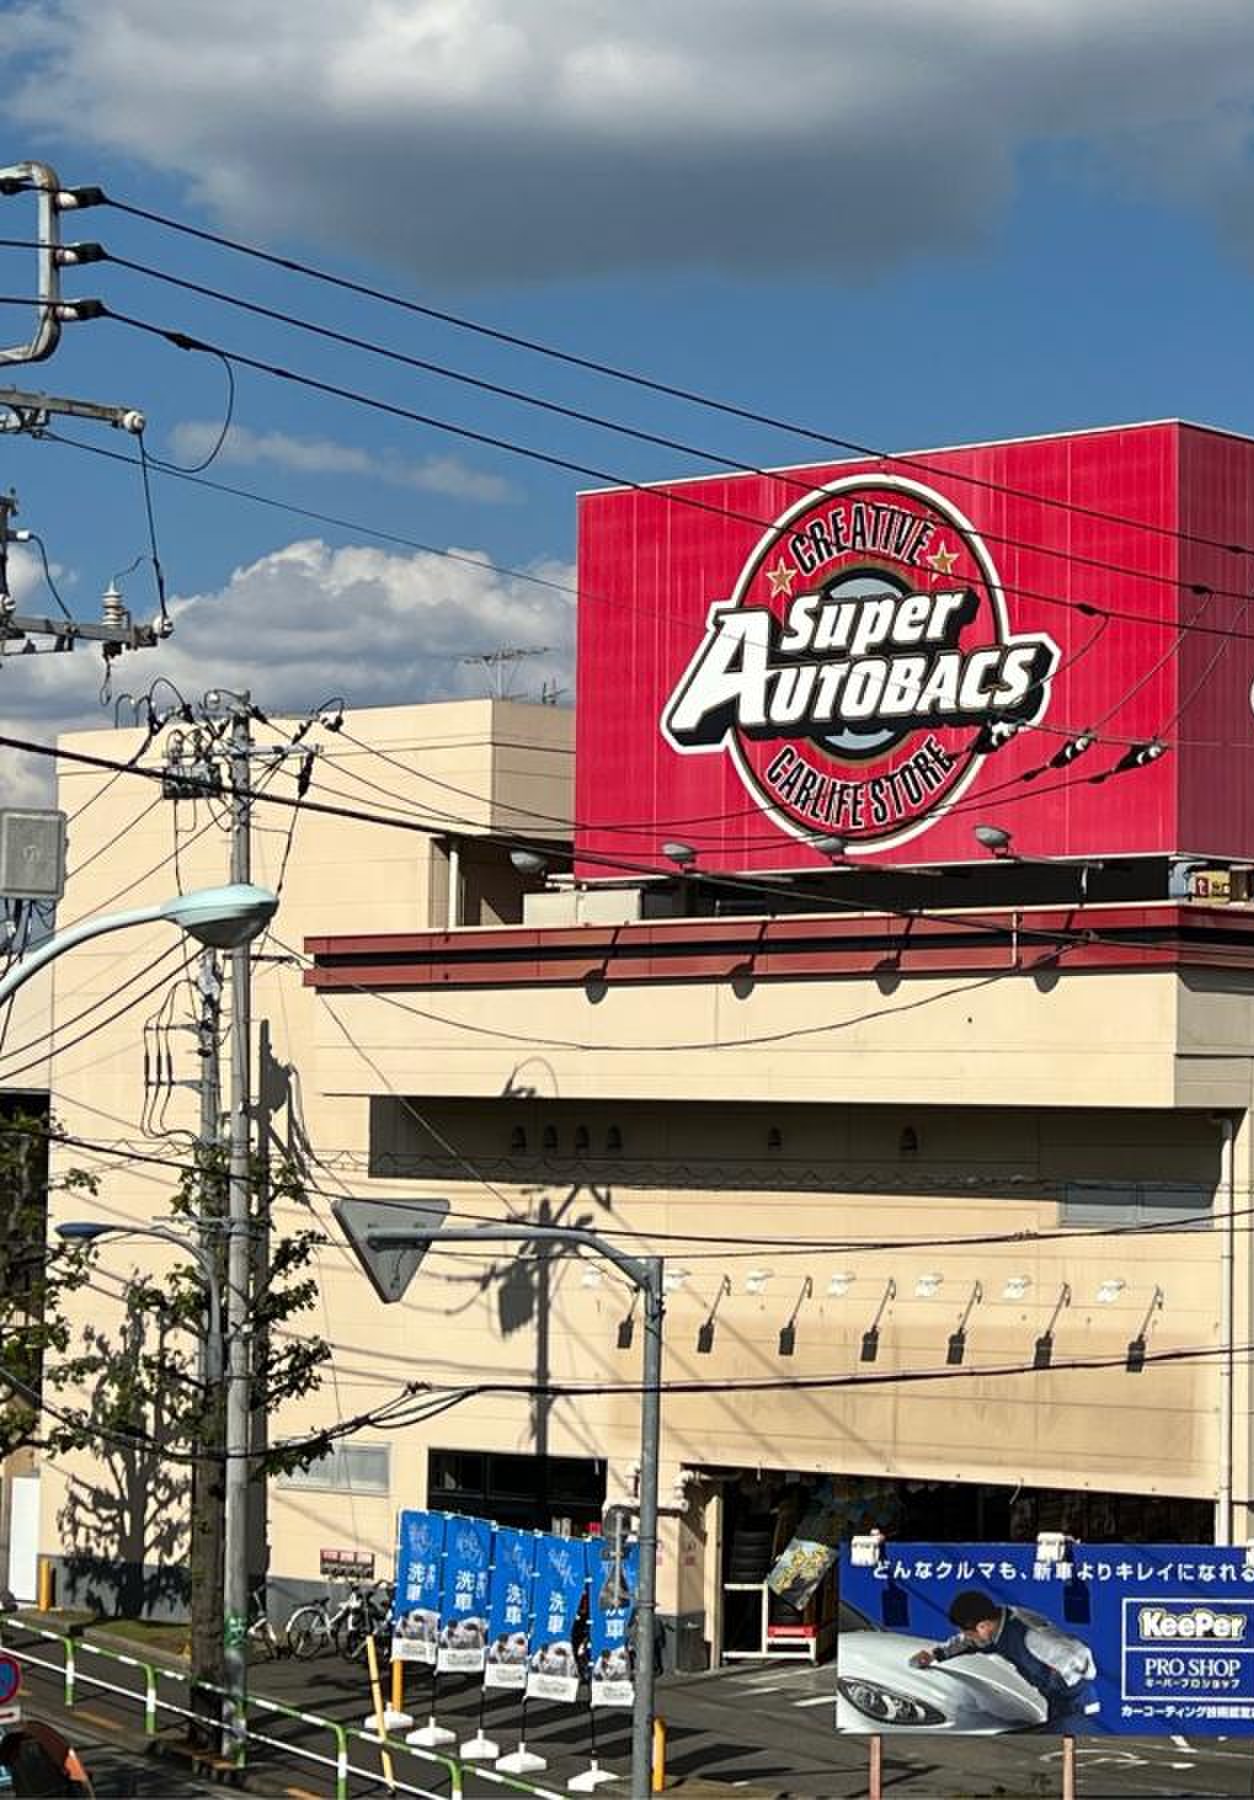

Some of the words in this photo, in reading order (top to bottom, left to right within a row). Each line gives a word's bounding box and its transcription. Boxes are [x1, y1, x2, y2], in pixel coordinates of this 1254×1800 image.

[790, 502, 932, 576] CREATIVE
[783, 590, 966, 654] Super
[667, 606, 1038, 735] AUTOBACS
[765, 746, 866, 829] CARLIFE
[868, 737, 957, 824] STORE
[454, 1569, 476, 1611] 洗車
[1140, 1609, 1245, 1639] KeePer
[1144, 1657, 1185, 1677] PRO
[1187, 1658, 1242, 1678] SHOP
